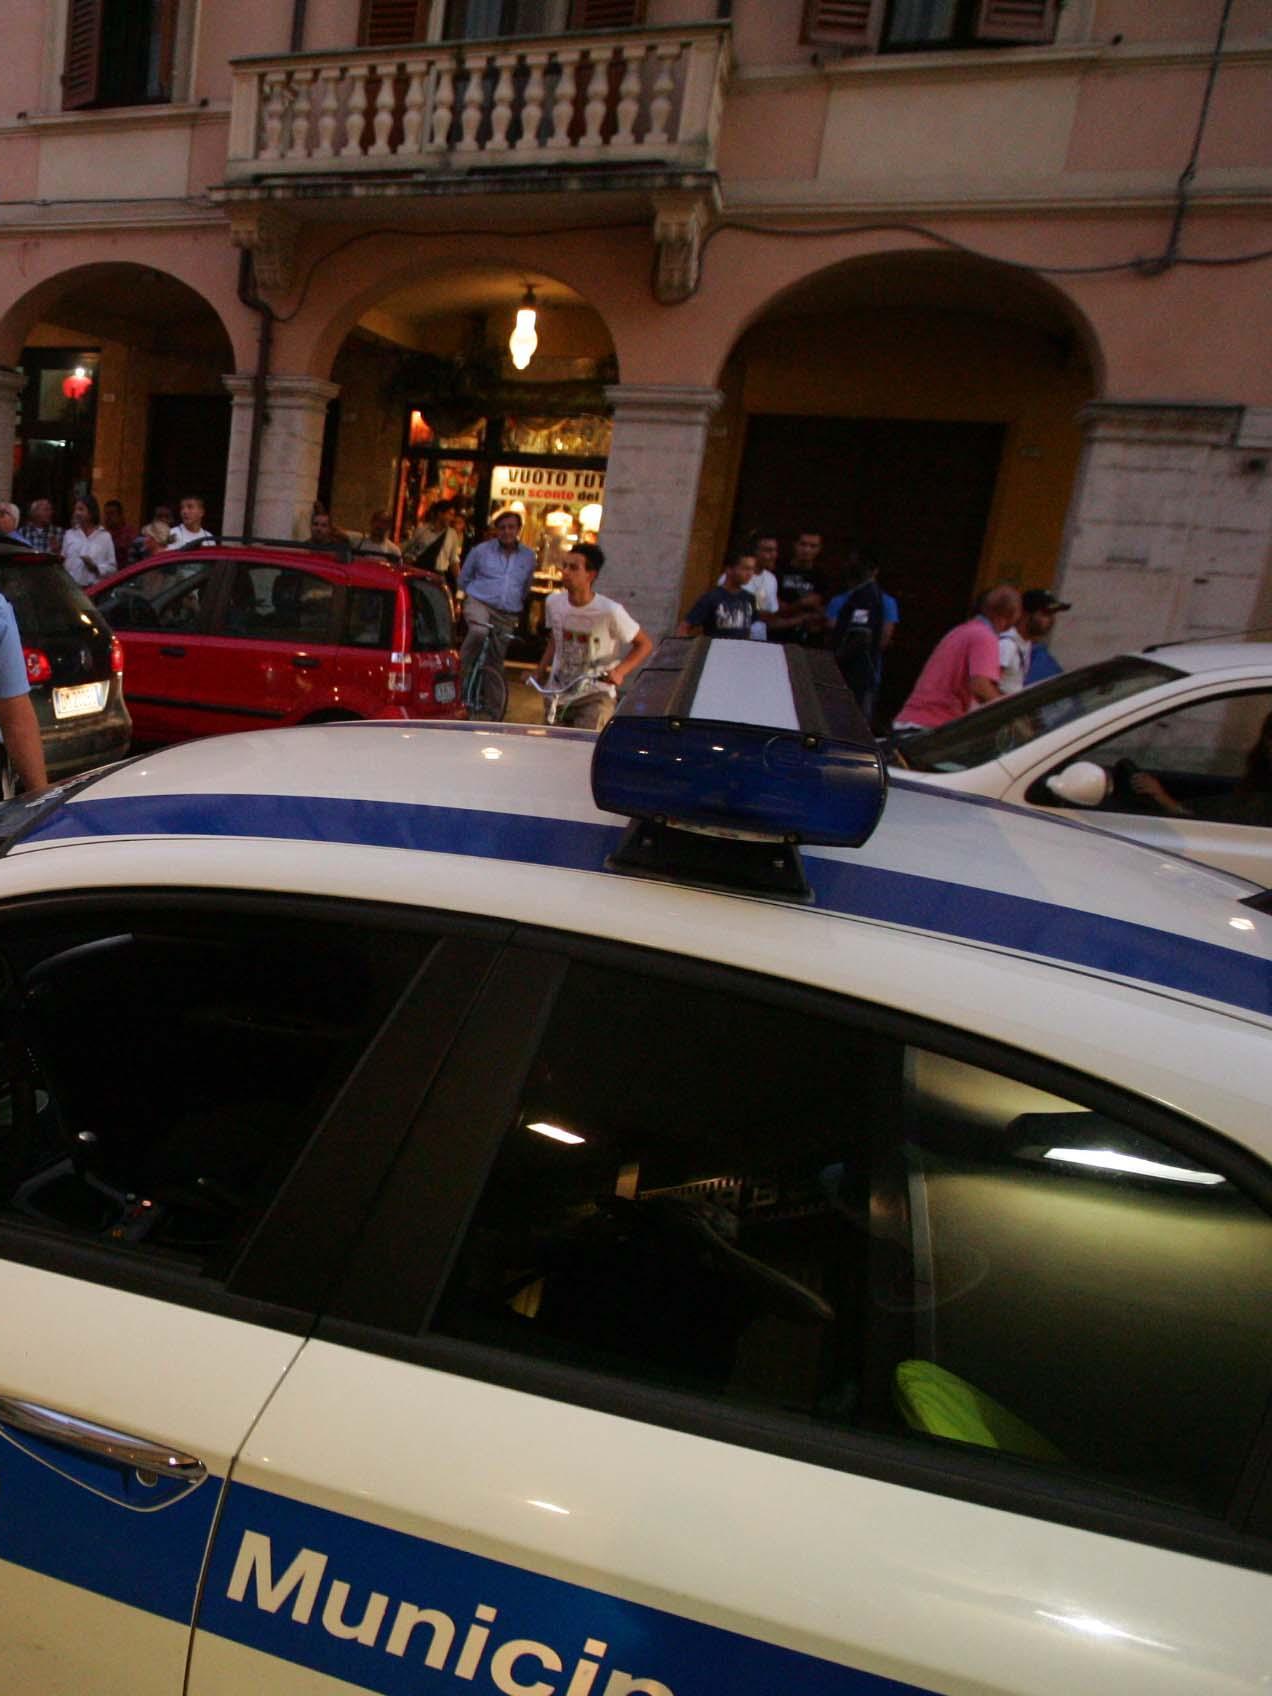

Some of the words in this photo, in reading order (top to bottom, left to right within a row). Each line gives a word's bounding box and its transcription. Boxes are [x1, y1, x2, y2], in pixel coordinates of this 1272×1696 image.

[508, 468, 567, 487] VUOTO
[500, 487, 525, 497] con
[528, 488, 575, 501] sconto
